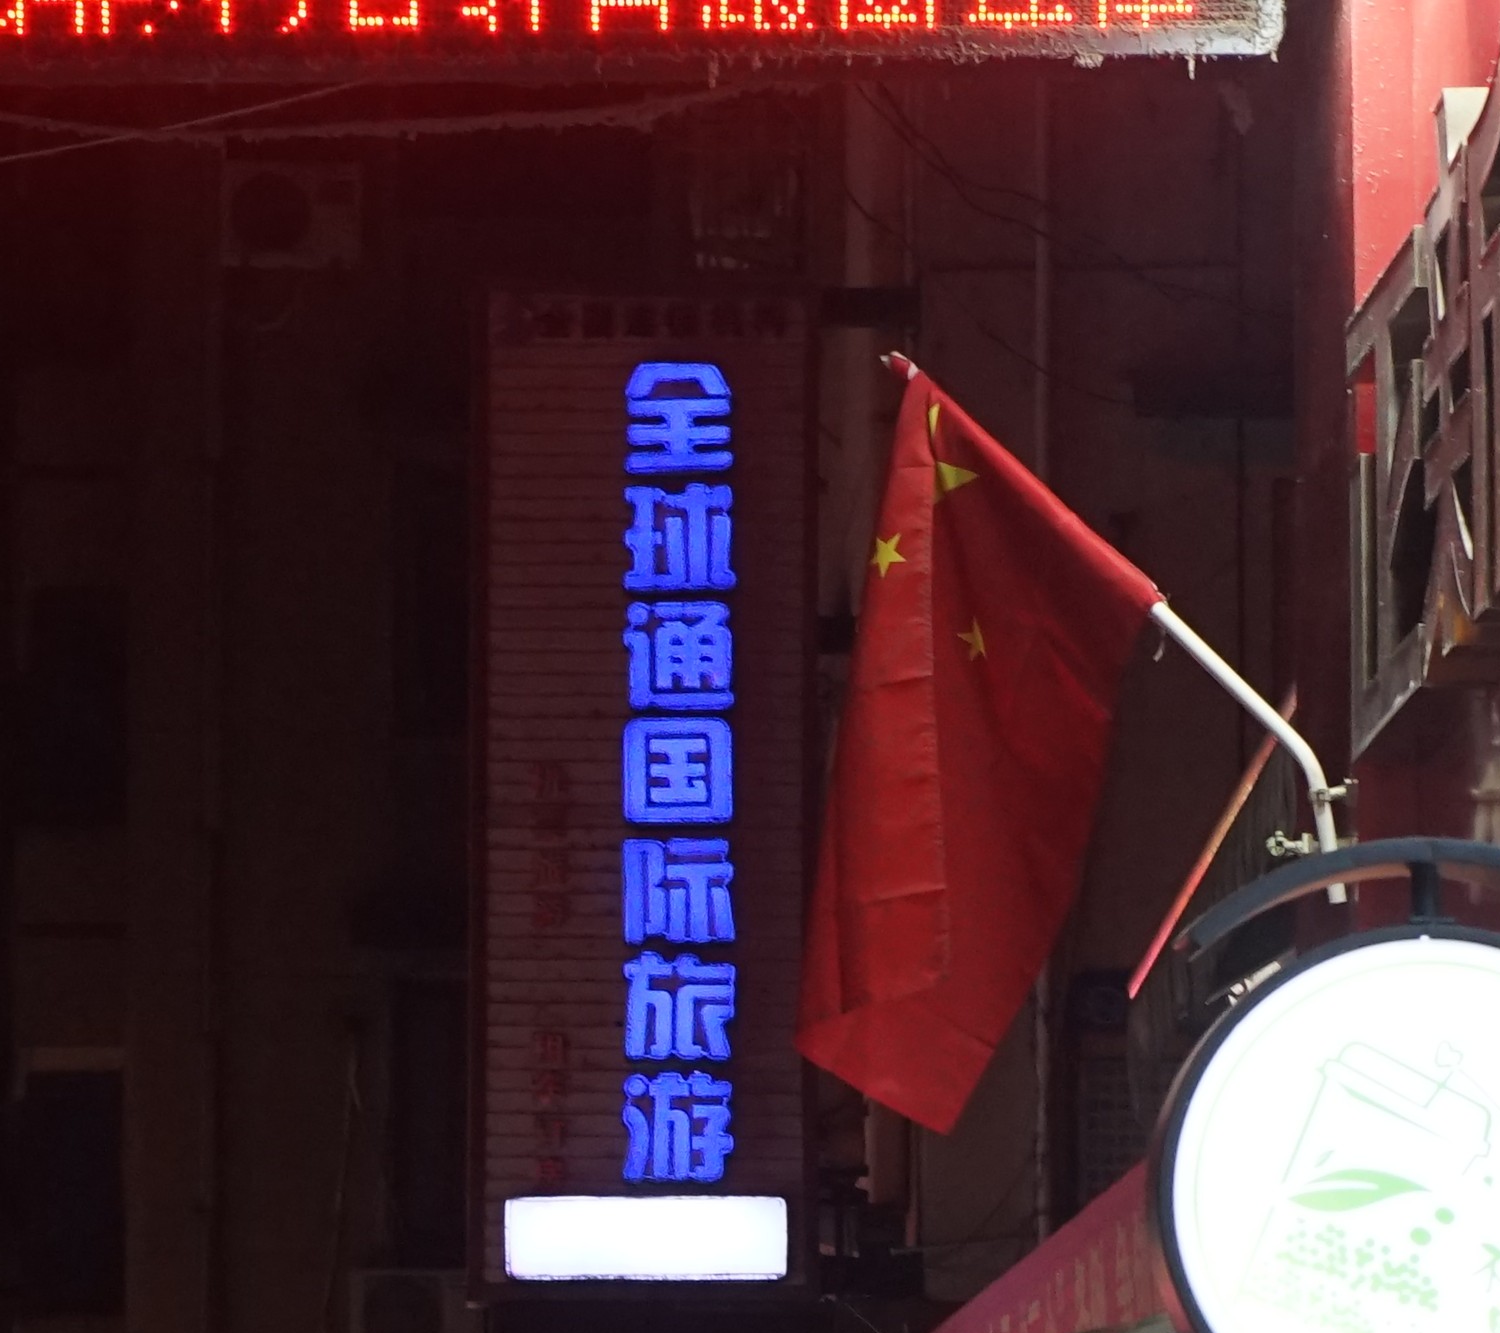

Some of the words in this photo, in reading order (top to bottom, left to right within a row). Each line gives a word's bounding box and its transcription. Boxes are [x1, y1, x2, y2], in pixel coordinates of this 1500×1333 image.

[621, 362, 736, 1182] 全球通国际旅游
